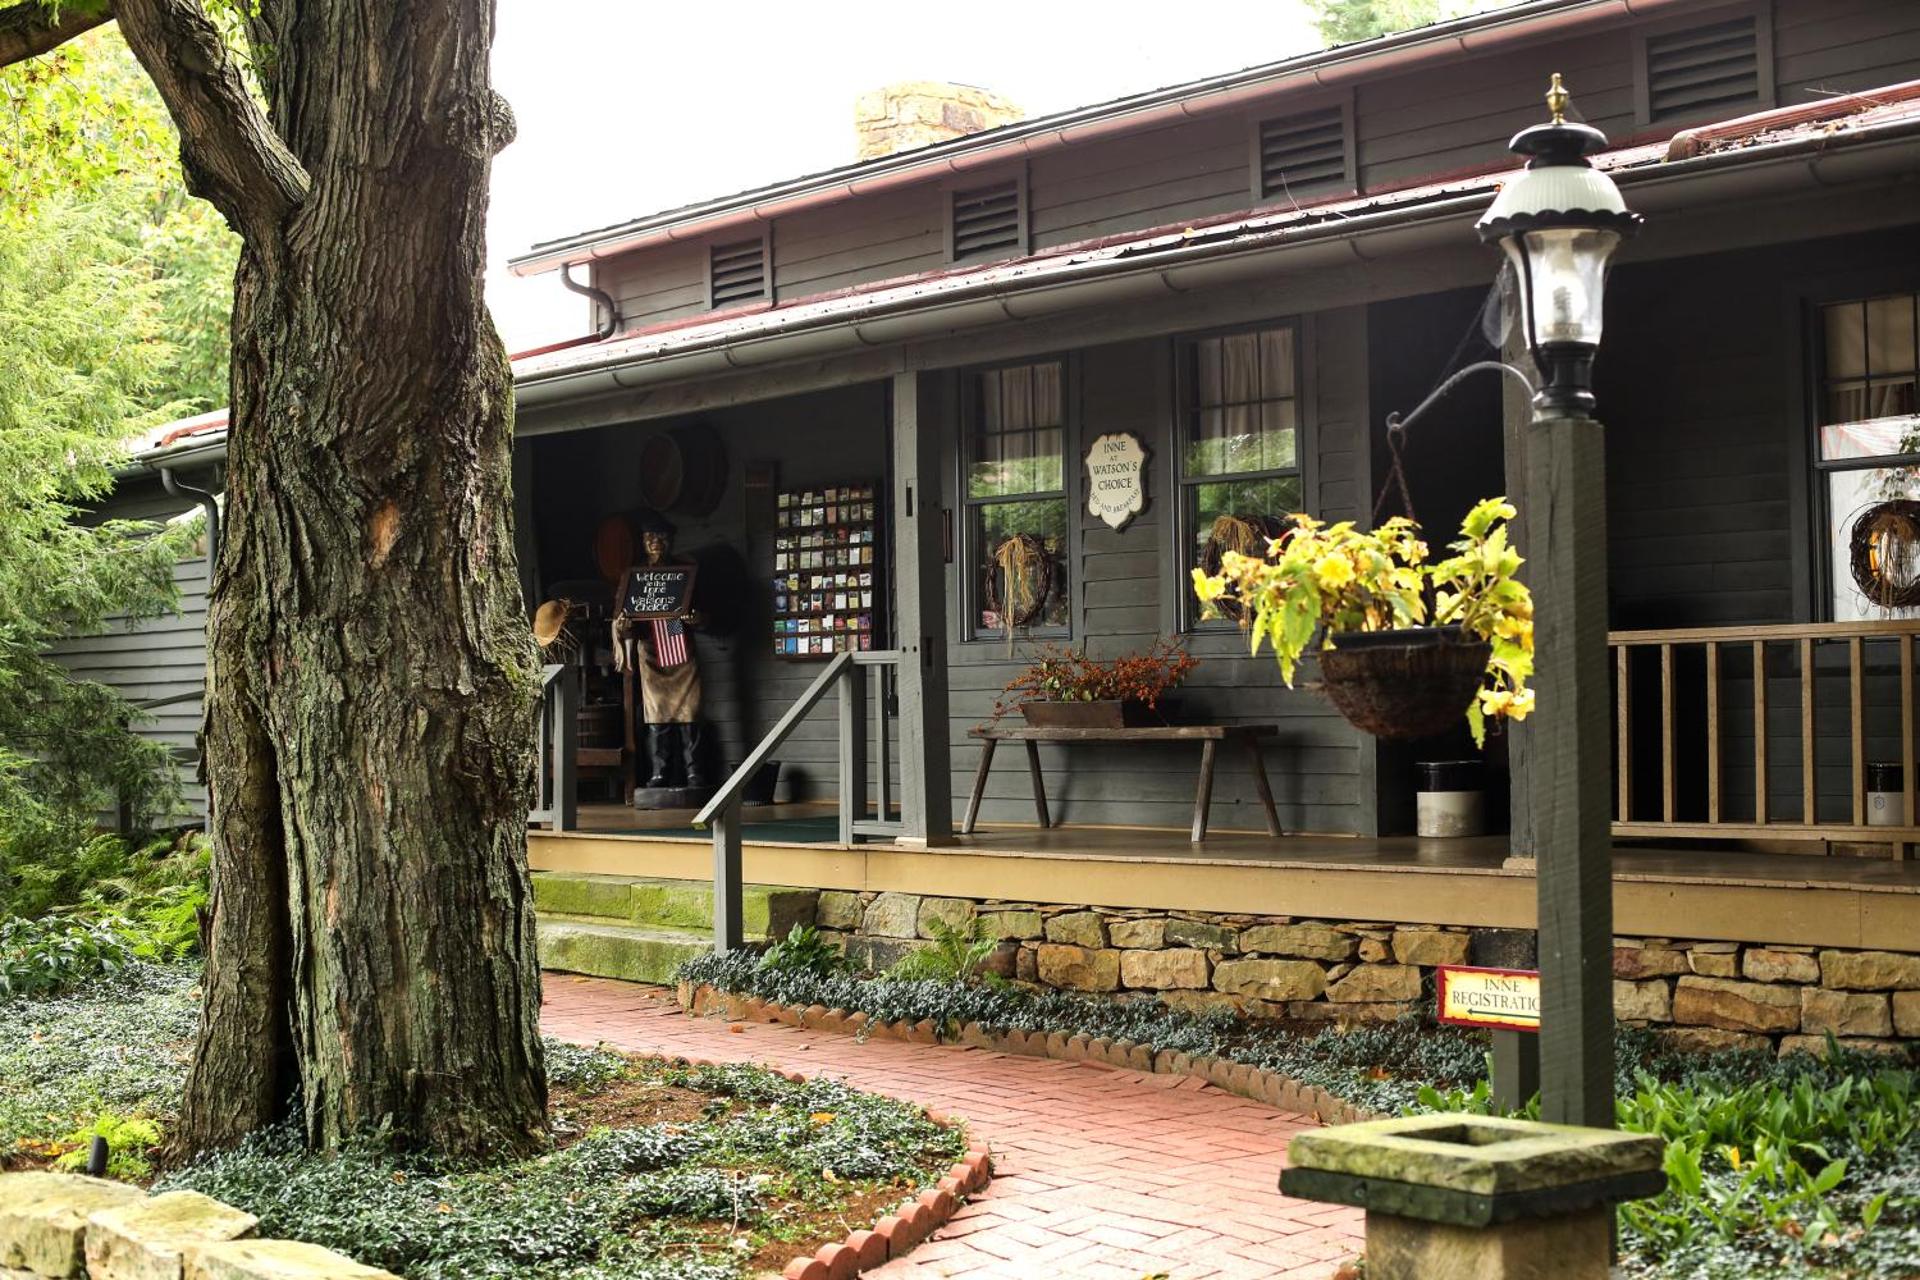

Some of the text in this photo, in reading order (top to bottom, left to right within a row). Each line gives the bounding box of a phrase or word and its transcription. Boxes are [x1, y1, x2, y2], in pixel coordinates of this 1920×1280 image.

[1104, 441, 1126, 454] INNE
[1093, 461, 1138, 476] WATSON'S
[1098, 477, 1133, 491] CHOICE
[636, 572, 685, 582] Welcome
[1485, 978, 1521, 993] INNE
[1452, 990, 1540, 1012] REGISTRATIO
